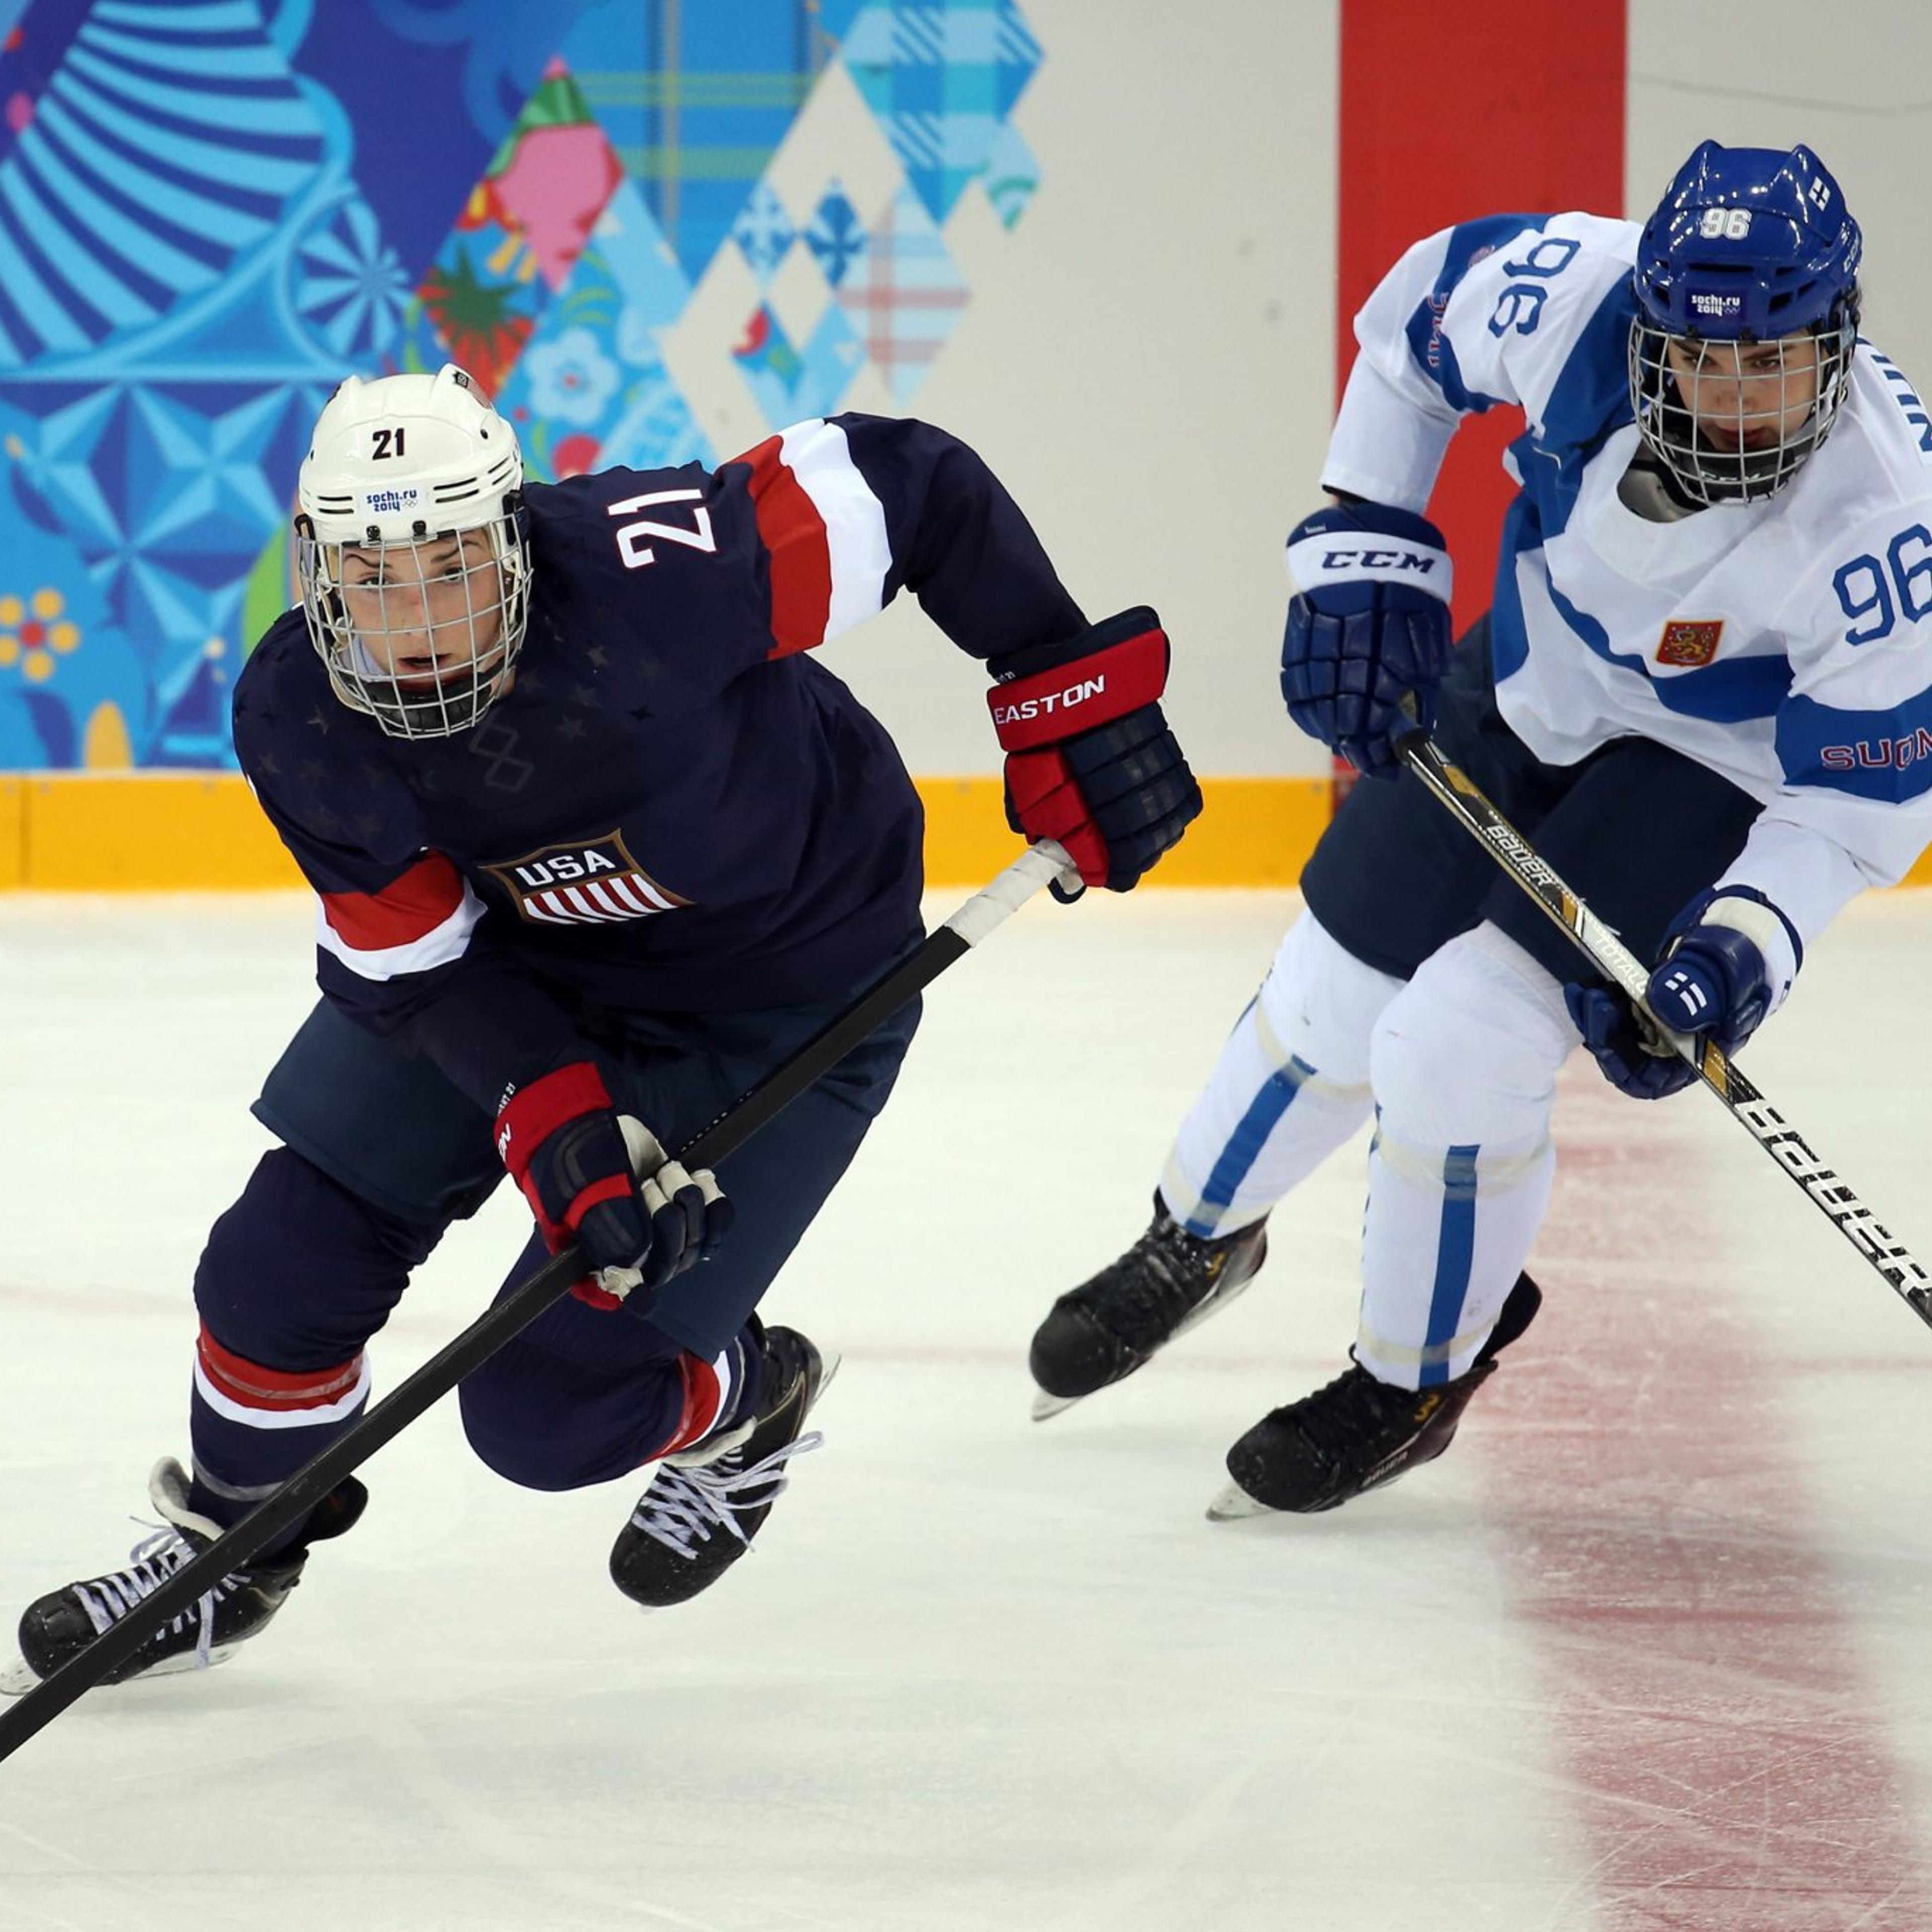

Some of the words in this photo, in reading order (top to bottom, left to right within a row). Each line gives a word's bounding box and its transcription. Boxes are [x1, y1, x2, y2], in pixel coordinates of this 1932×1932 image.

[1700, 207, 1752, 240] 96
[1488, 237, 1581, 338] 96
[1692, 294, 1740, 306] sochi.ru
[1697, 304, 1722, 317] 2014
[372, 428, 405, 460] 21
[366, 490, 417, 504] sochi.ru
[374, 501, 400, 512] 2014
[607, 489, 716, 568] 21
[1322, 551, 1435, 573] CCM
[1832, 523, 1932, 646] 96
[994, 675, 1104, 724] EASTON
[515, 850, 616, 887] USA
